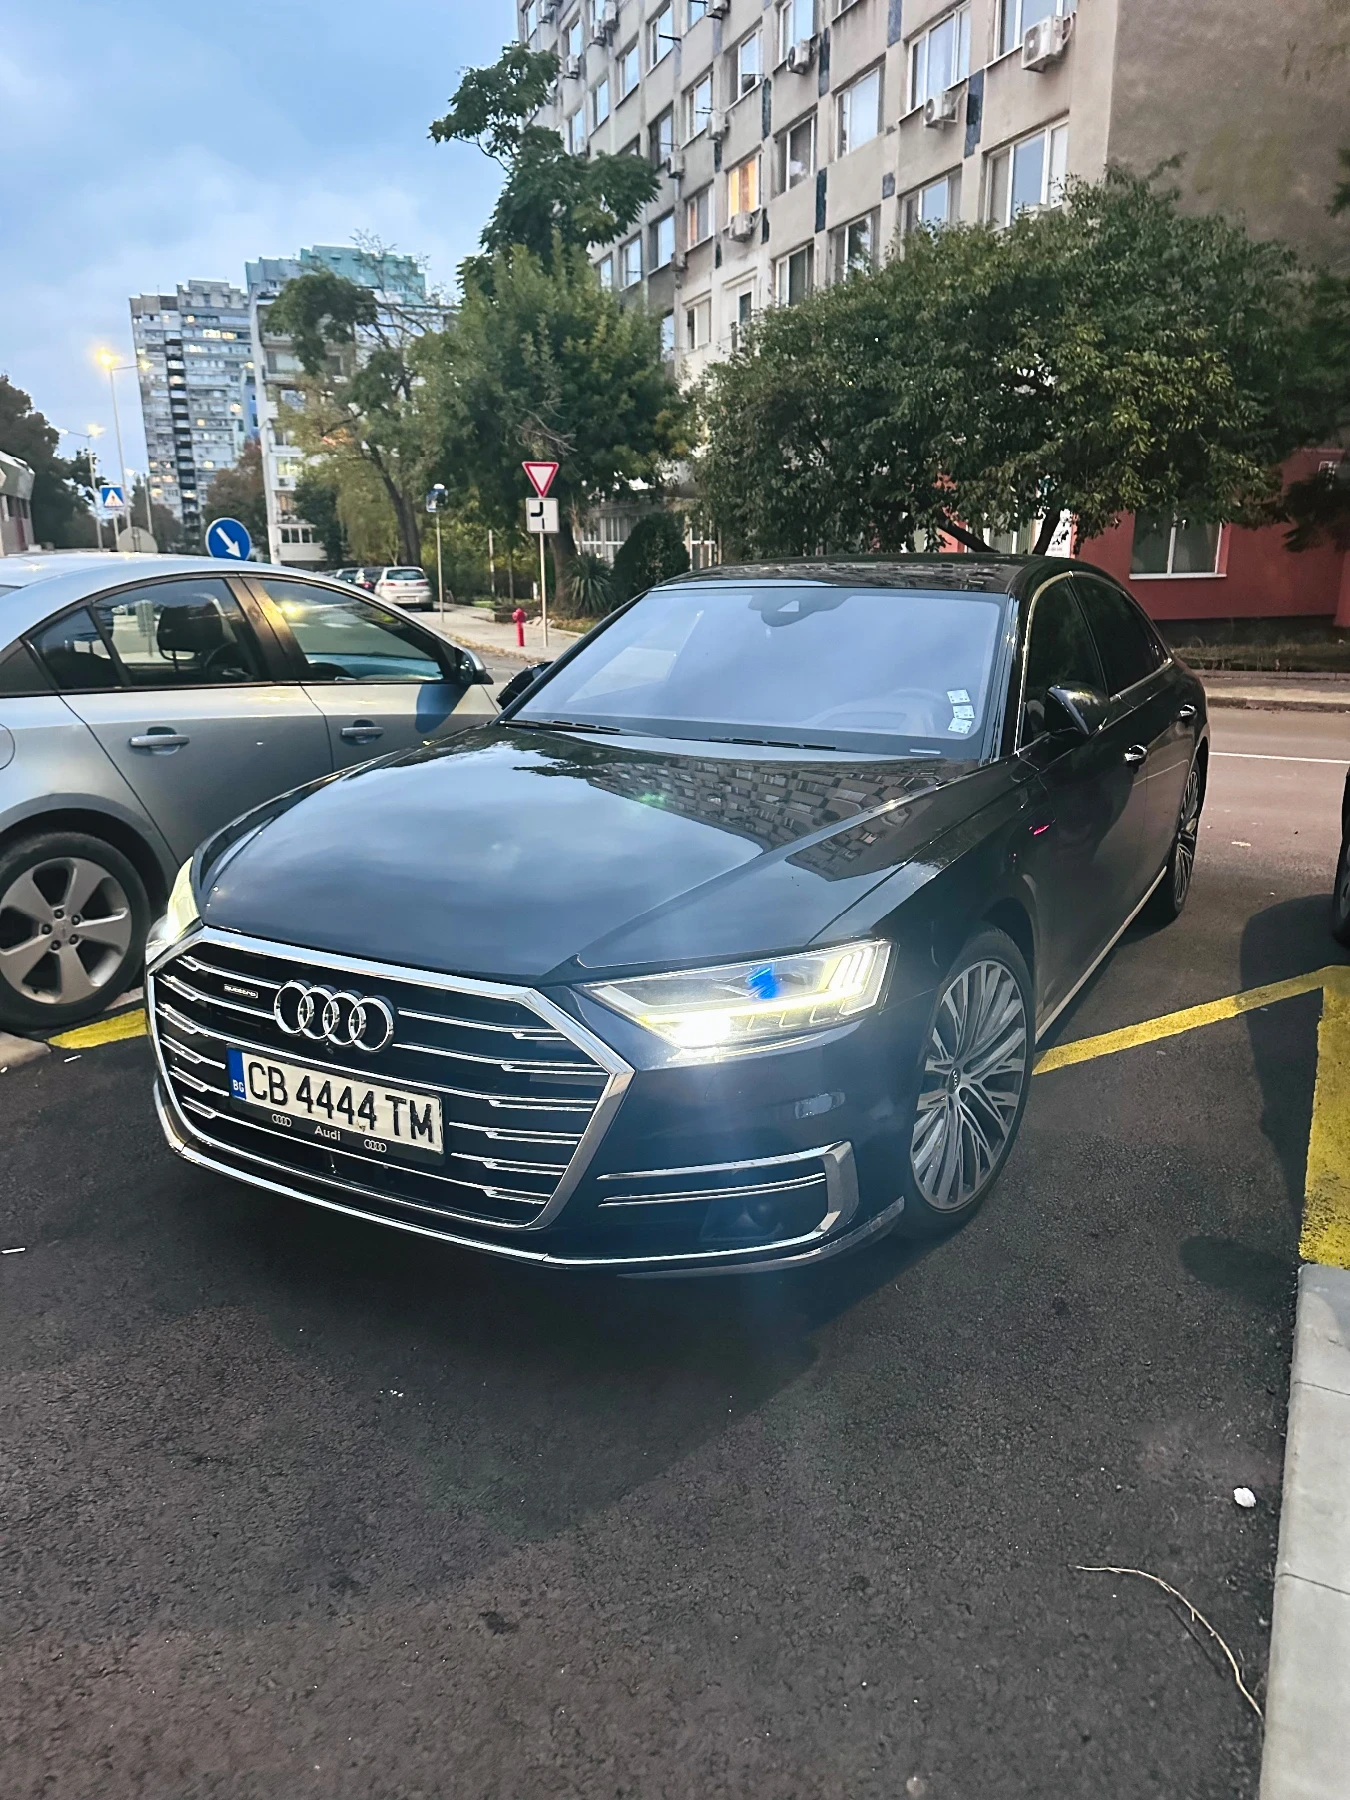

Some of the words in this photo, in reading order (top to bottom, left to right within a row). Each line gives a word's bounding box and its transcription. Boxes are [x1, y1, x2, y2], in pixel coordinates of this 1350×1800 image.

[233, 1079, 245, 1093] BG
[248, 1061, 288, 1106] CB
[296, 1075, 377, 1131] 4444
[385, 1094, 434, 1144] TM
[314, 1125, 341, 1141] Audi
